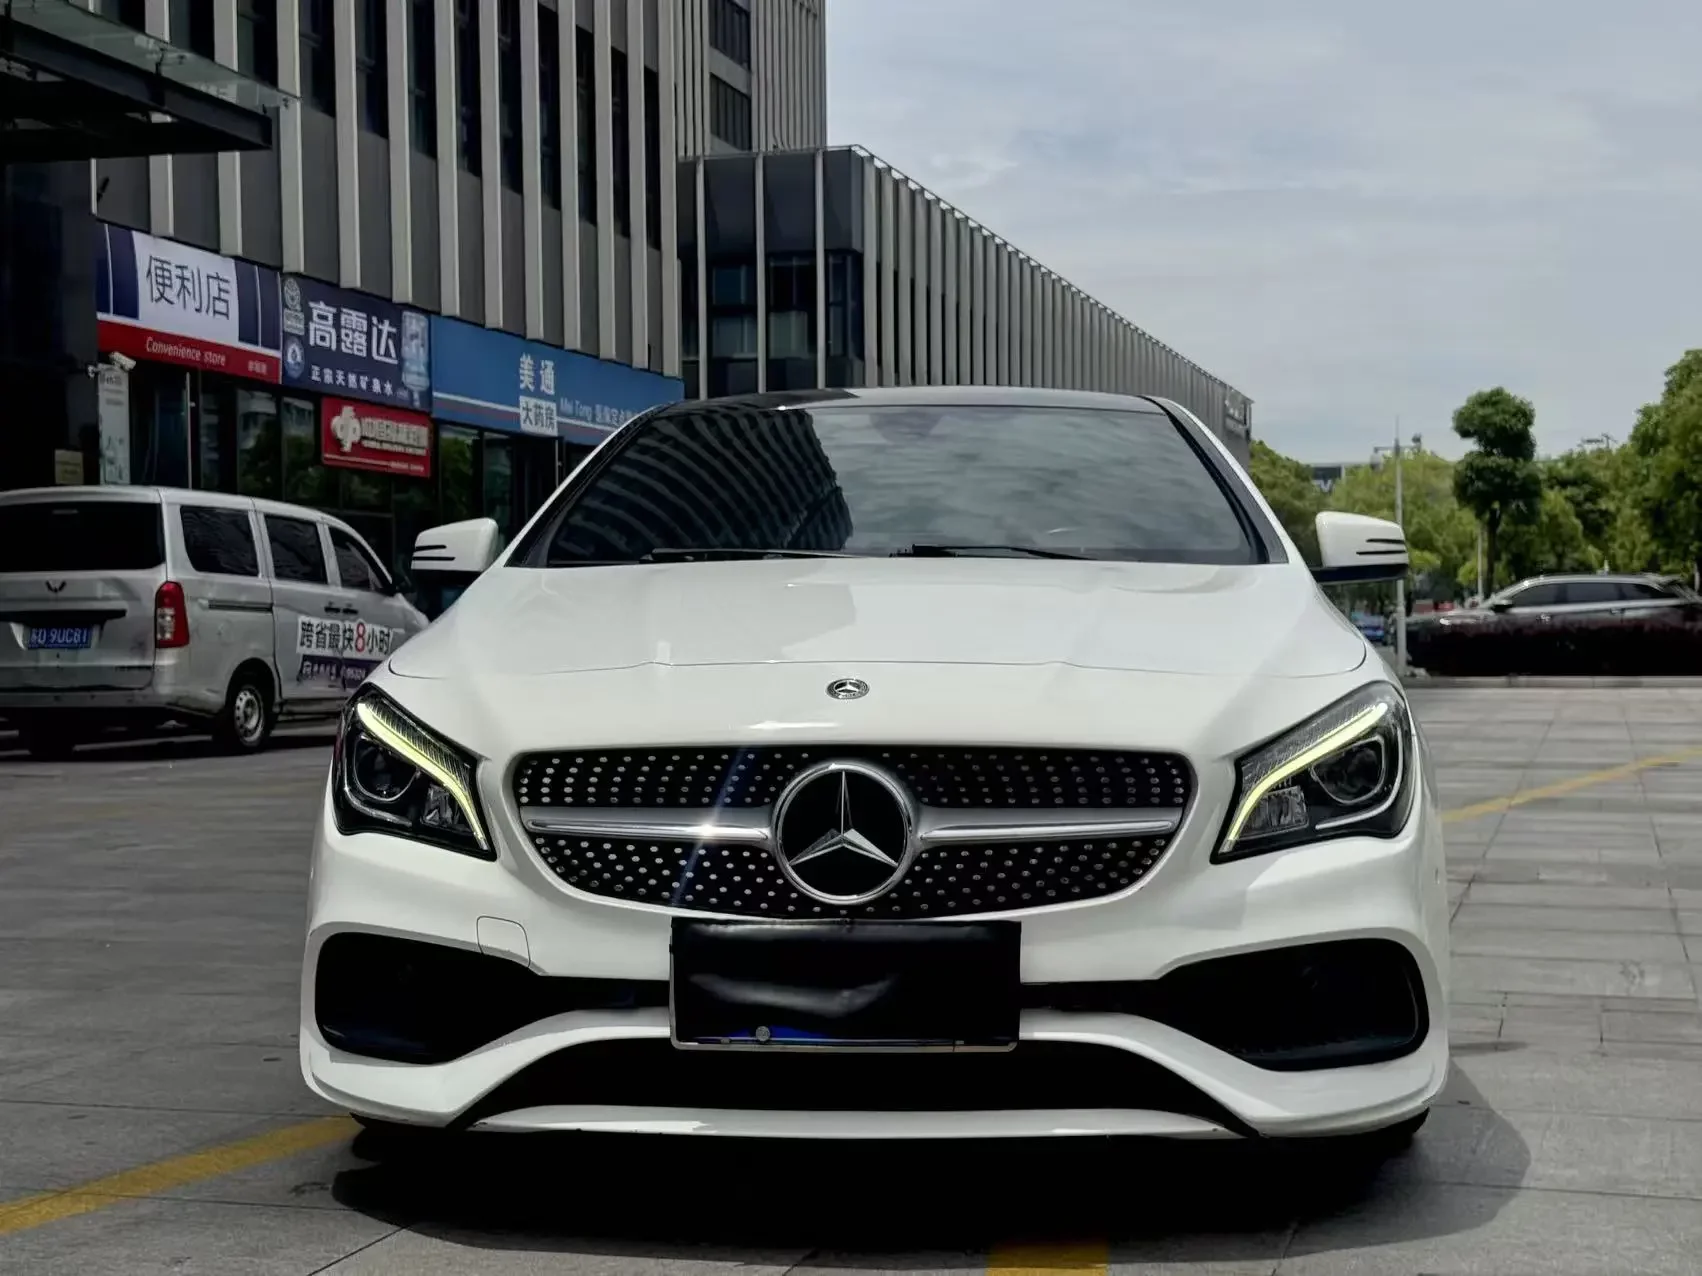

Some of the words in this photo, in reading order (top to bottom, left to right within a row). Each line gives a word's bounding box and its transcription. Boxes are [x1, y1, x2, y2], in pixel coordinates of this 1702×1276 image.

[146, 255, 232, 321] 便利店
[146, 336, 201, 361] Convenience
[203, 350, 226, 367] store
[308, 301, 399, 365] 高露达
[519, 354, 555, 395] 美通
[521, 400, 557, 432] 大药房
[299, 620, 392, 655] 跨省最快8小时
